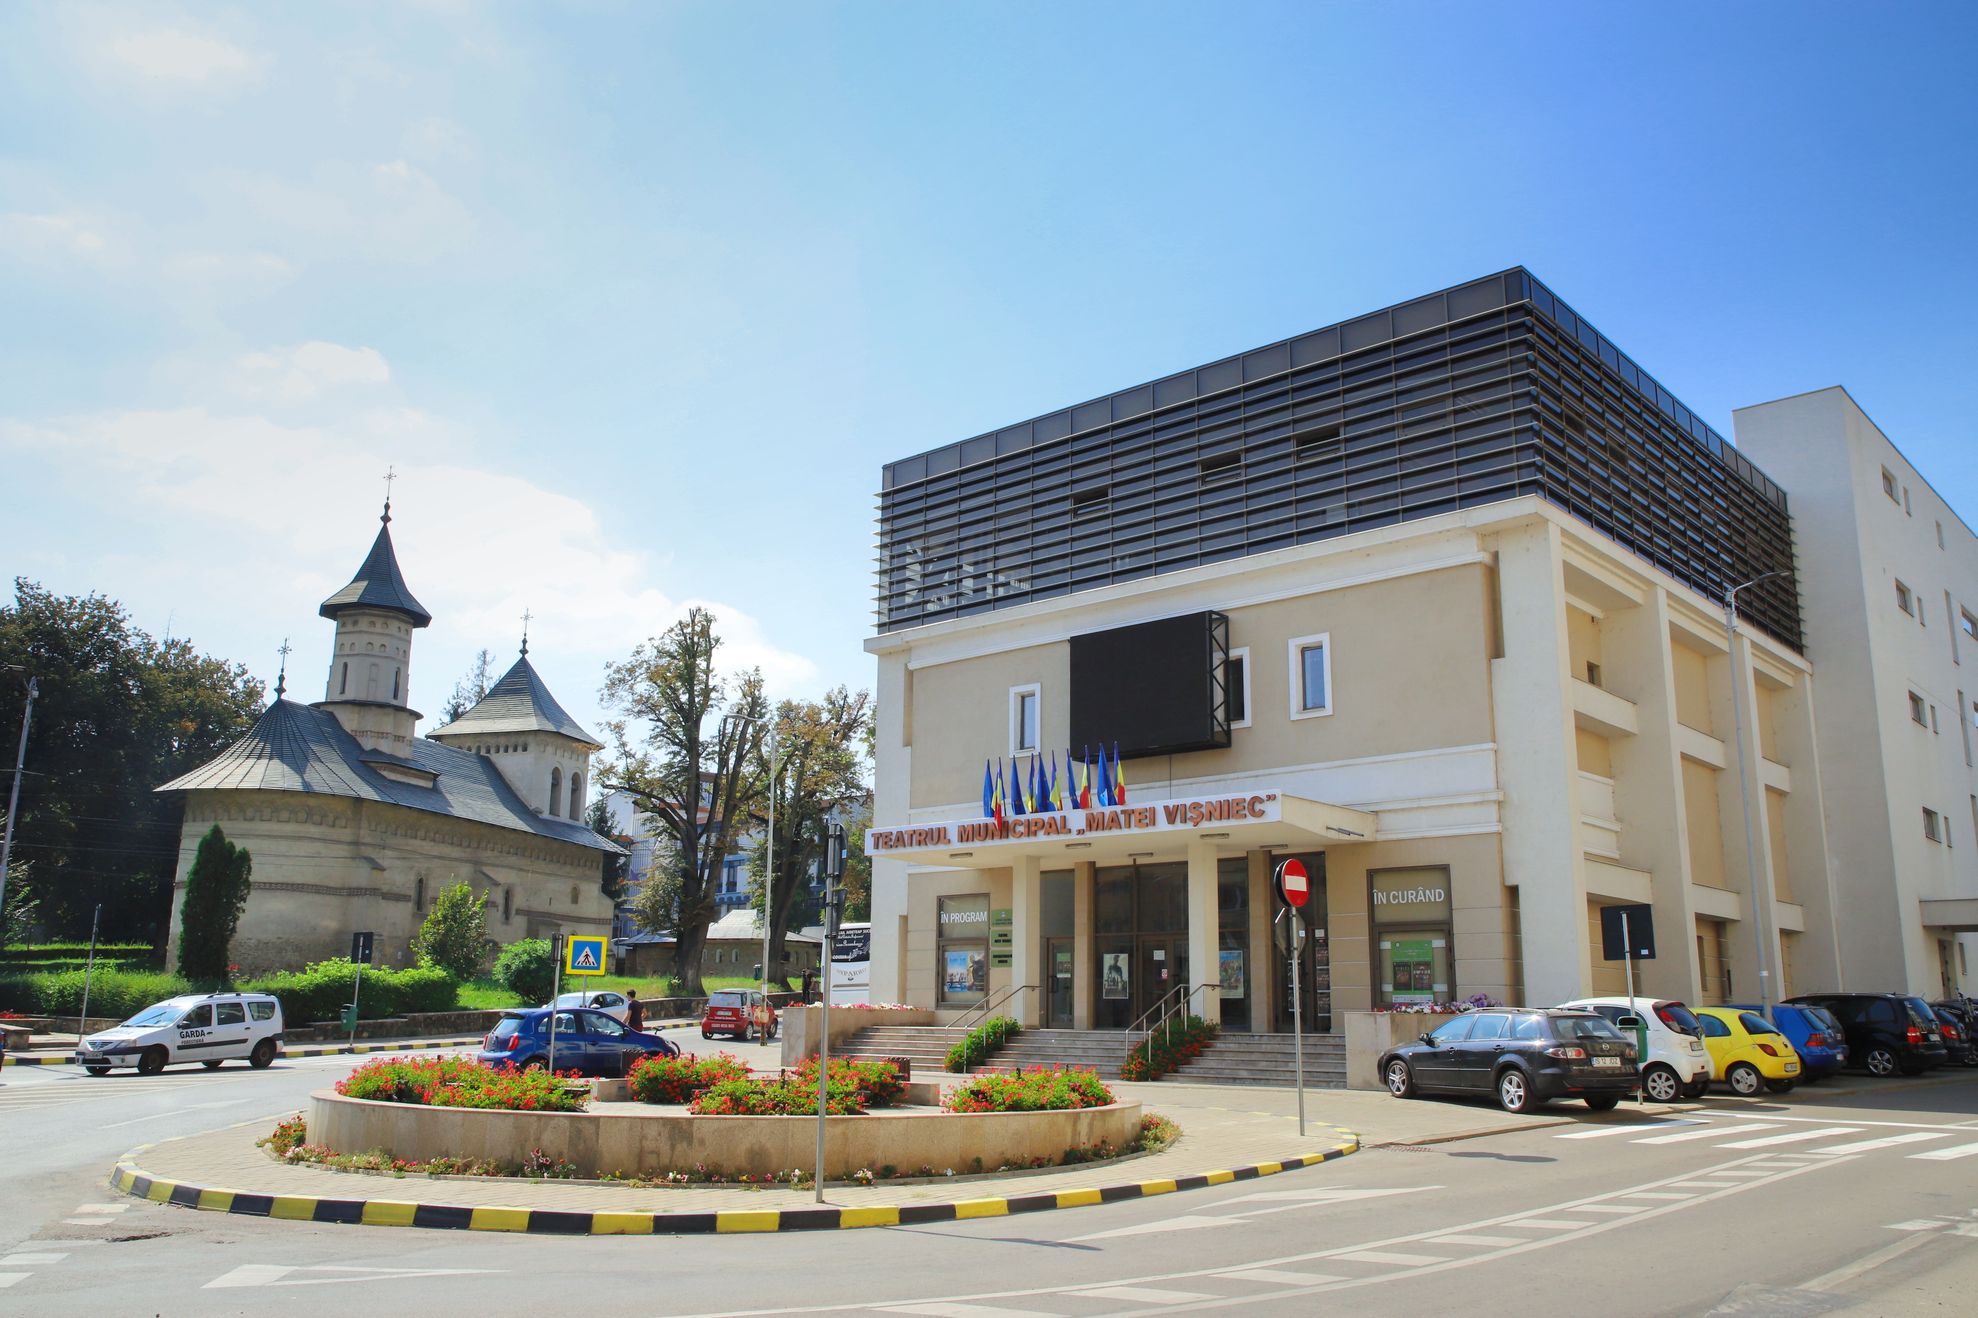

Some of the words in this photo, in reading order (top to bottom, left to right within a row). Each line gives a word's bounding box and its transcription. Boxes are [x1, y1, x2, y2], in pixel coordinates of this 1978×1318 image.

[871, 826, 950, 850] TEATRUL
[957, 815, 1071, 843] MUNICIPAL
[1373, 888, 1387, 905] ÎN
[1390, 887, 1444, 904] CURÂND
[941, 911, 949, 924] ÎN
[950, 911, 987, 923] PROGRAM
[180, 1030, 206, 1039] GARDA
